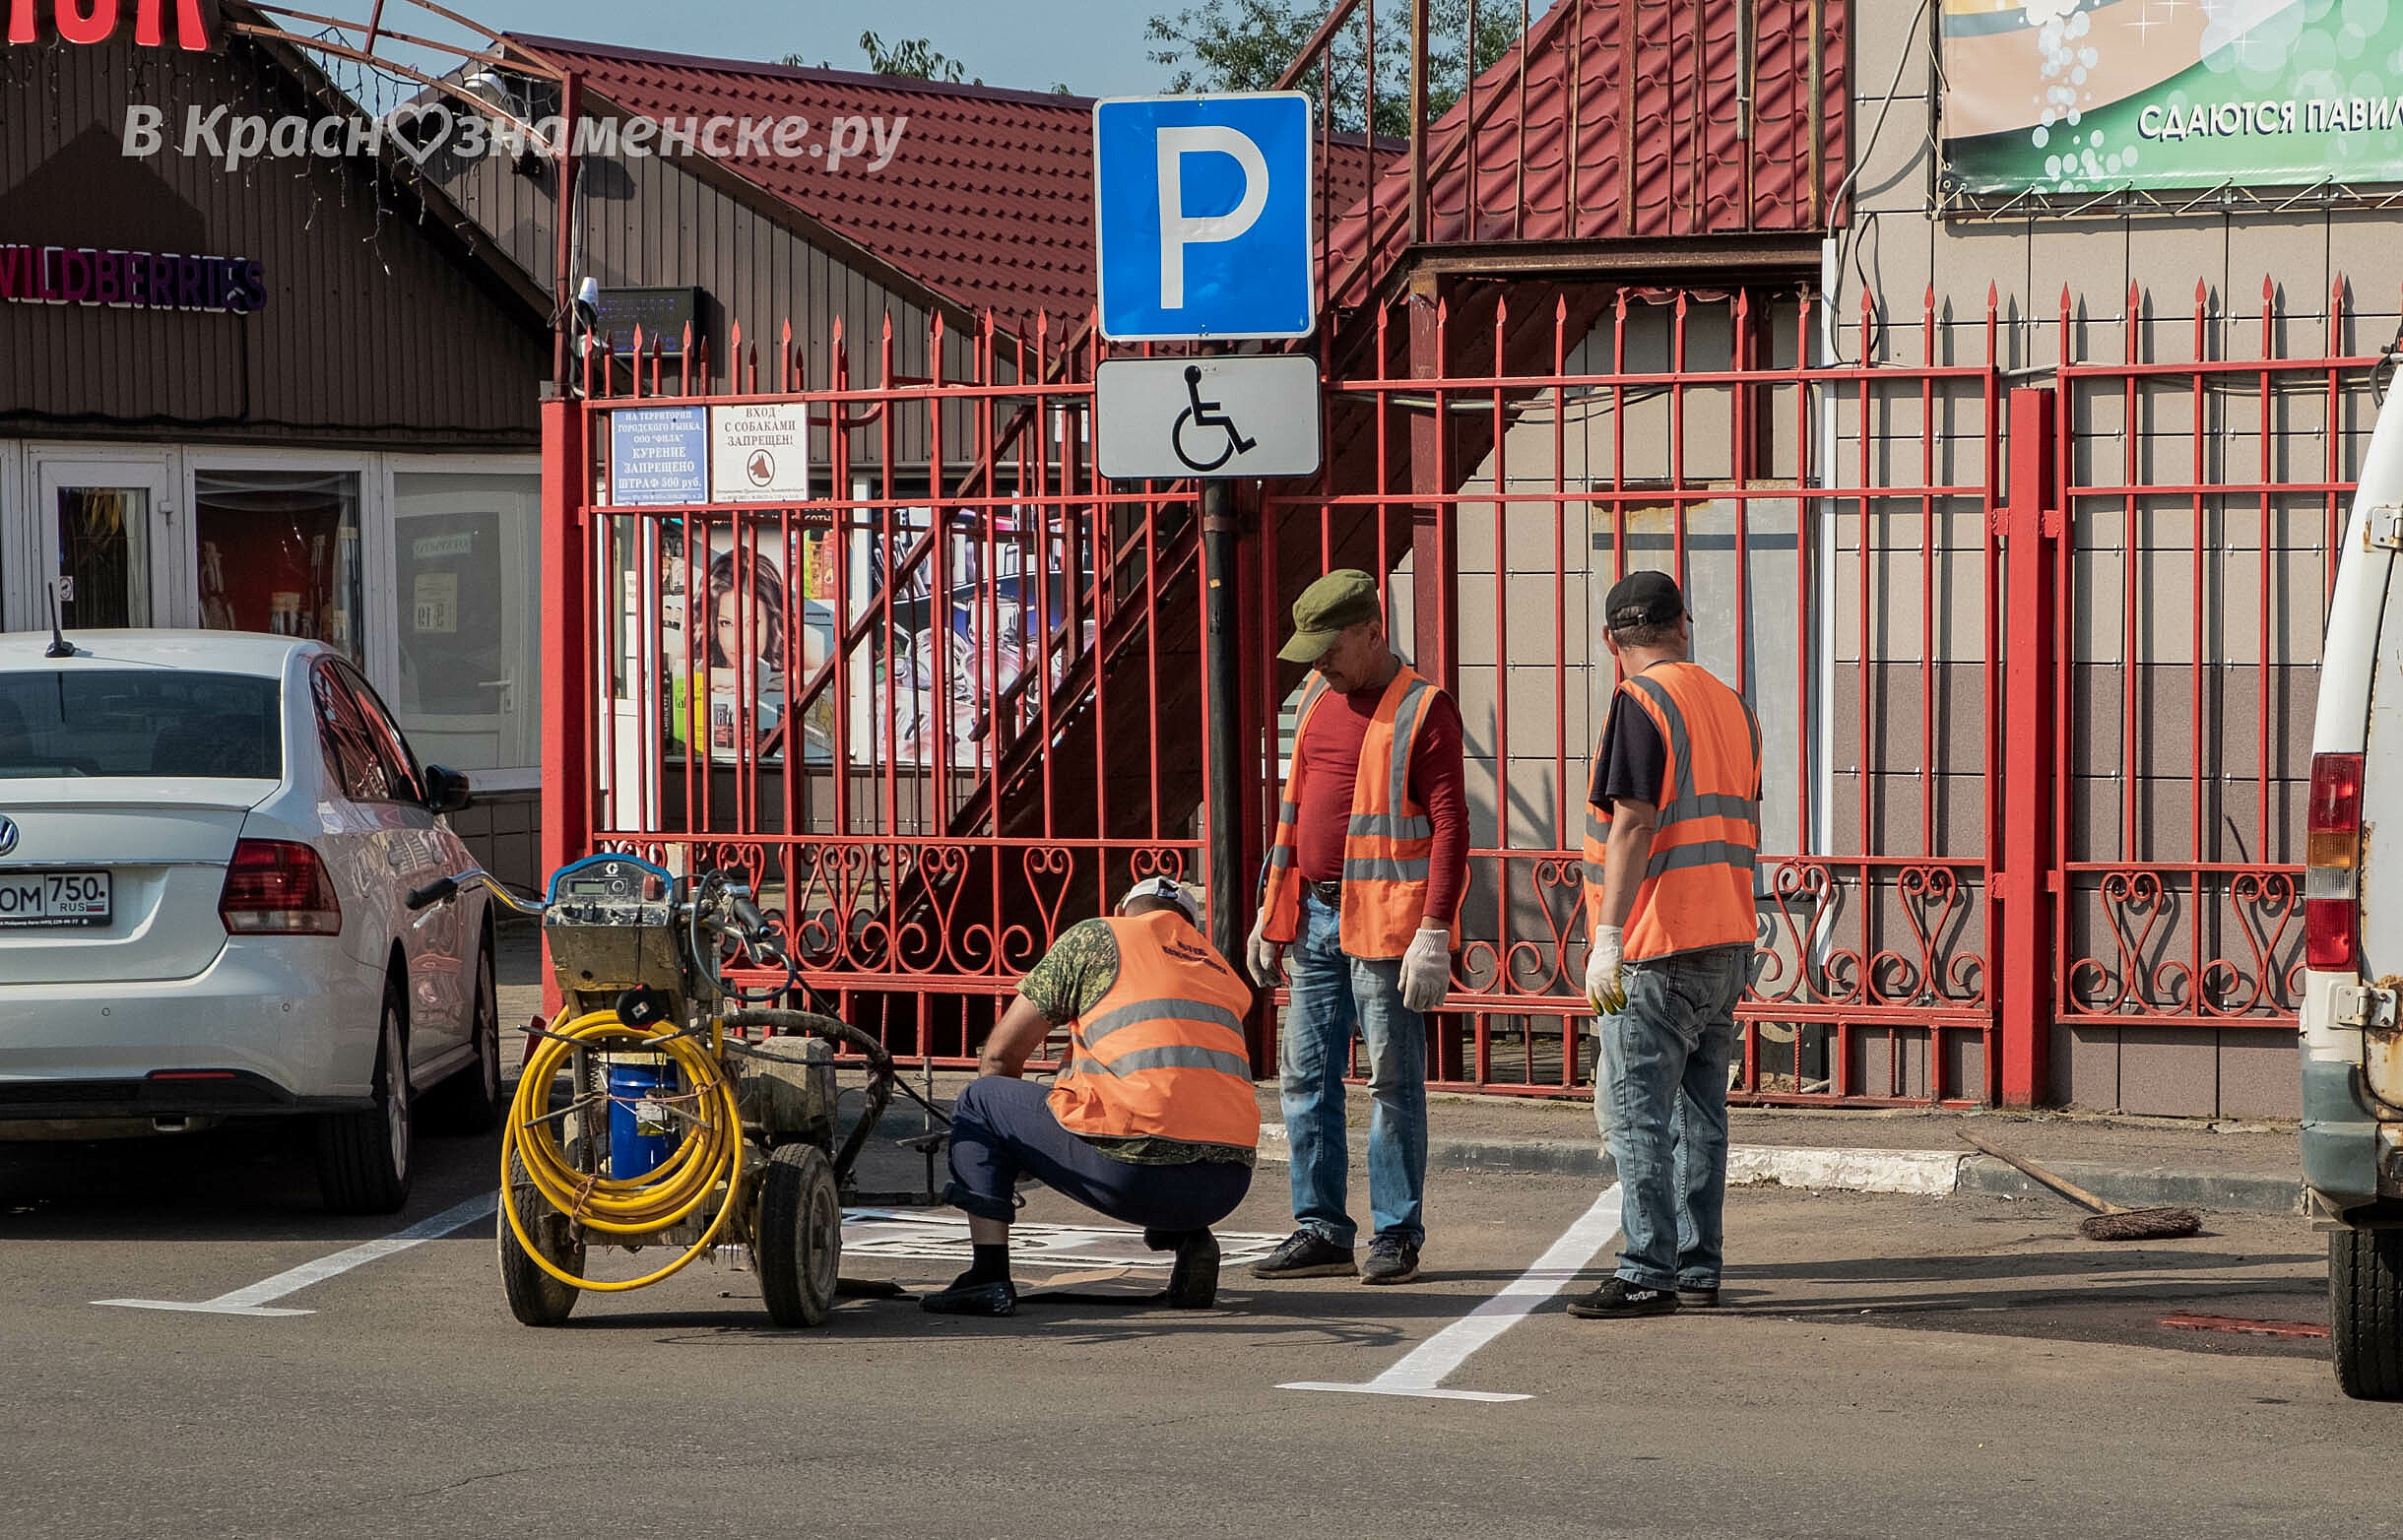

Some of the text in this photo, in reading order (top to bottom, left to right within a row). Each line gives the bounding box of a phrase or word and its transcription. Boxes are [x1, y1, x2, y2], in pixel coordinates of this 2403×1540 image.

[2137, 99, 2297, 142] СДАЮТСЯ
[1156, 125, 1269, 309] P
[746, 407, 776, 417] ВХОД
[724, 420, 796, 432] С СОБАКАМИ
[728, 435, 793, 447] ЗАПРЕЩЕН!
[632, 446, 685, 459] КУРЕНИЕ
[623, 461, 694, 475] ЗАПРЕЩЕНО
[617, 477, 701, 489] ШТРАФ 500 руб.
[47, 876, 98, 902] 750
[59, 902, 86, 912] RUS
